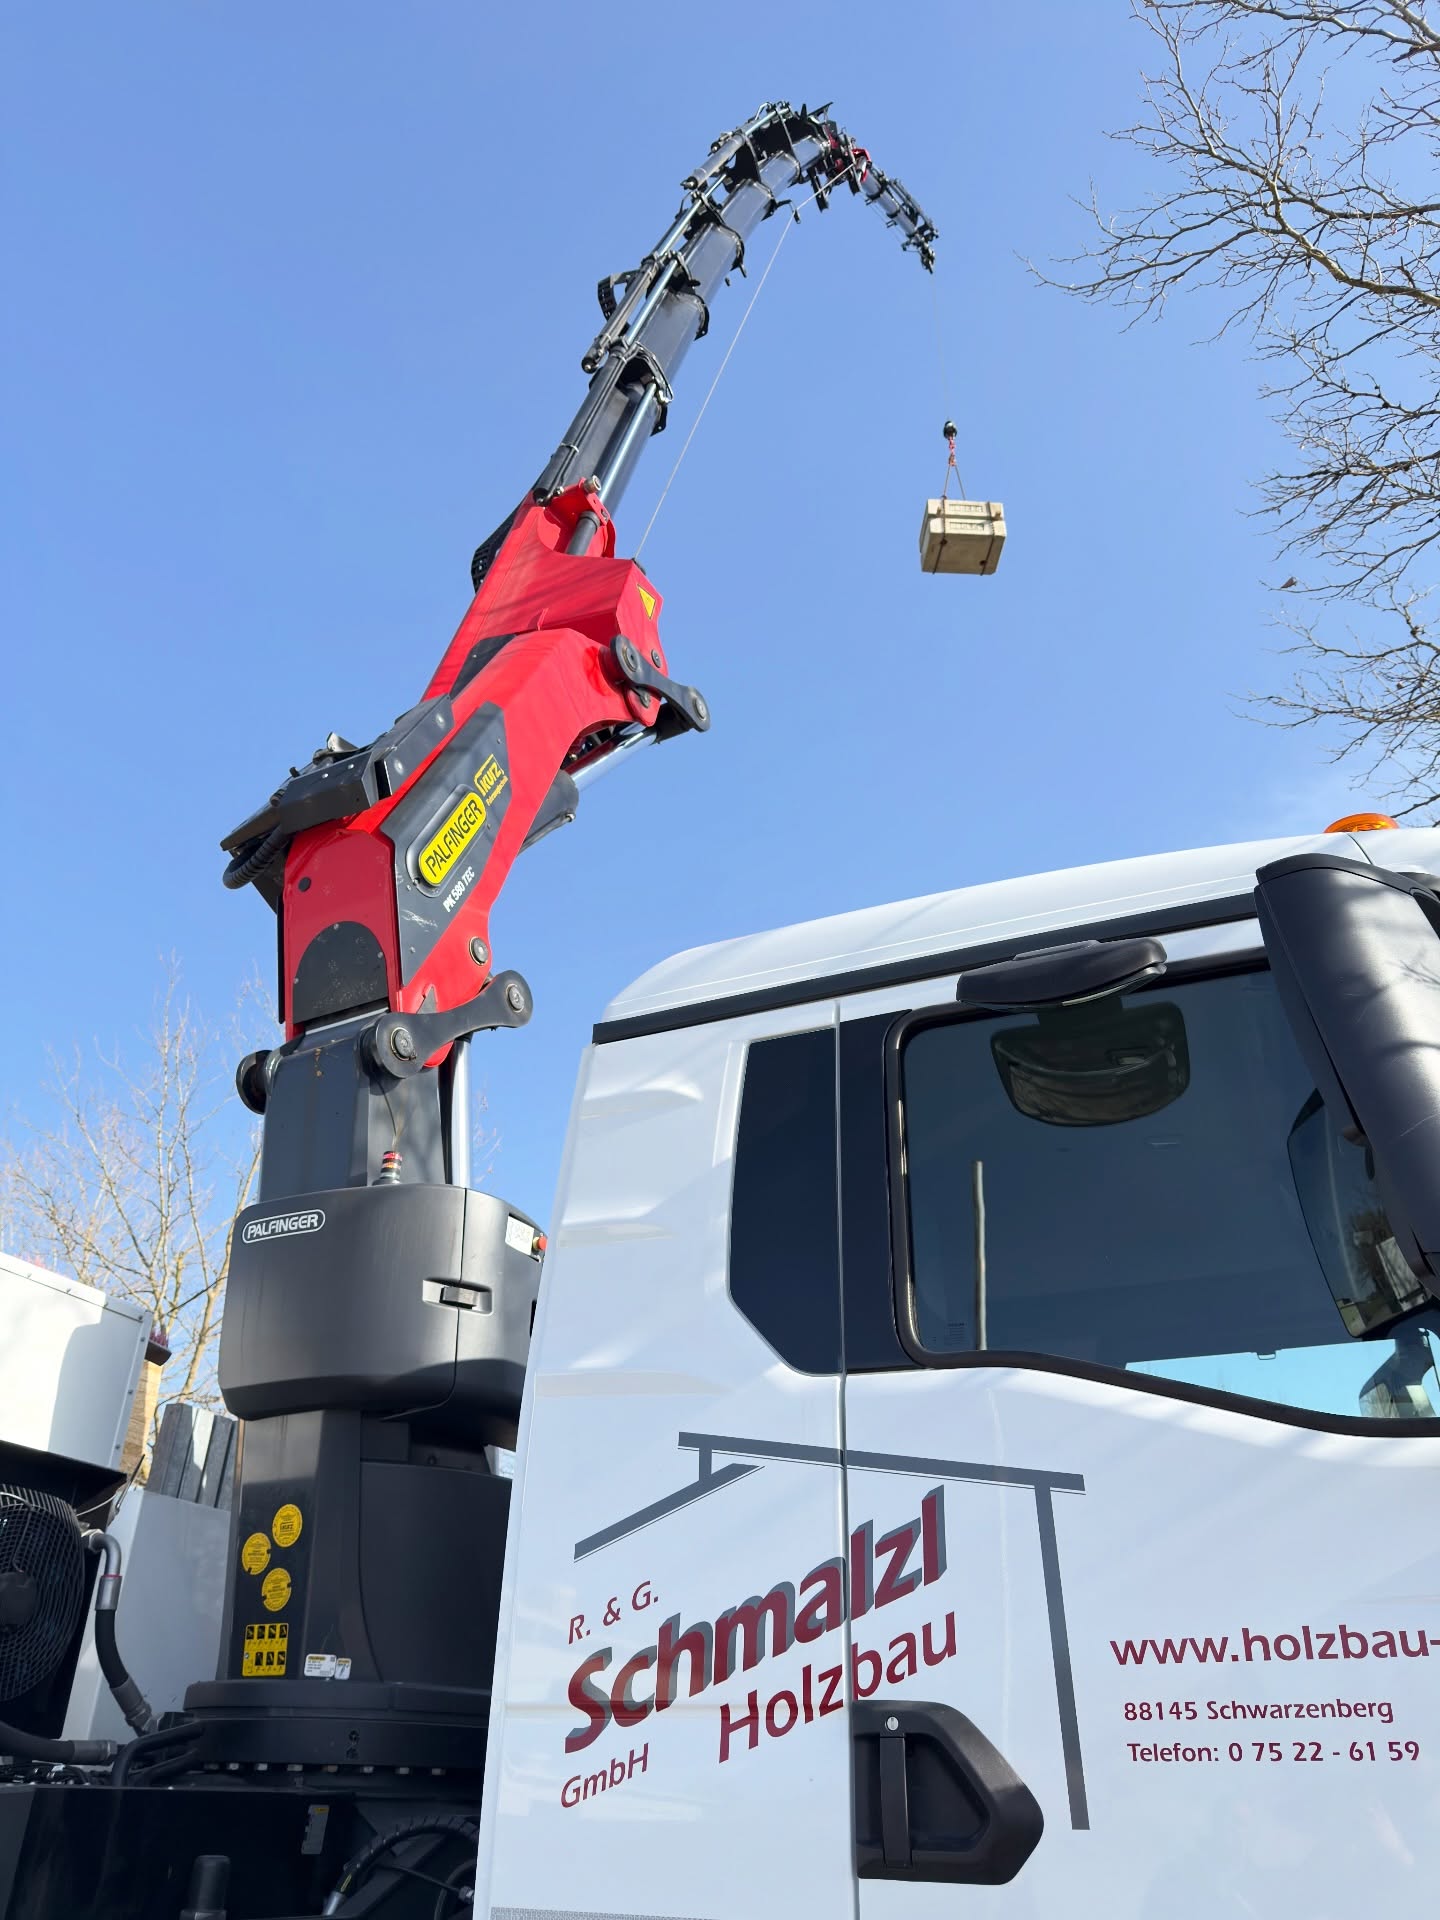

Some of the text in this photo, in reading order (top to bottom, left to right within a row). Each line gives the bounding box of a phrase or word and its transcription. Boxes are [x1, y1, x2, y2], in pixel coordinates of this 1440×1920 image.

[425, 799, 483, 877] PALFINGER
[443, 866, 475, 912] PK 580 TEC
[247, 1214, 319, 1239] PALFINGER
[565, 1485, 947, 1753] Schmalzl
[568, 1581, 659, 1644] R. & G.
[719, 1611, 957, 1763] Holzbau
[1124, 1698, 1394, 1724] 88145 Schwarzenberg
[561, 1743, 649, 1808] GmbH
[1127, 1742, 1219, 1762] Telefon:
[1229, 1742, 1243, 1762] 0
[1252, 1742, 1283, 1761] 75
[1293, 1741, 1324, 1761] 22
[1349, 1741, 1376, 1761] 61
[1388, 1740, 1420, 1761] 59
